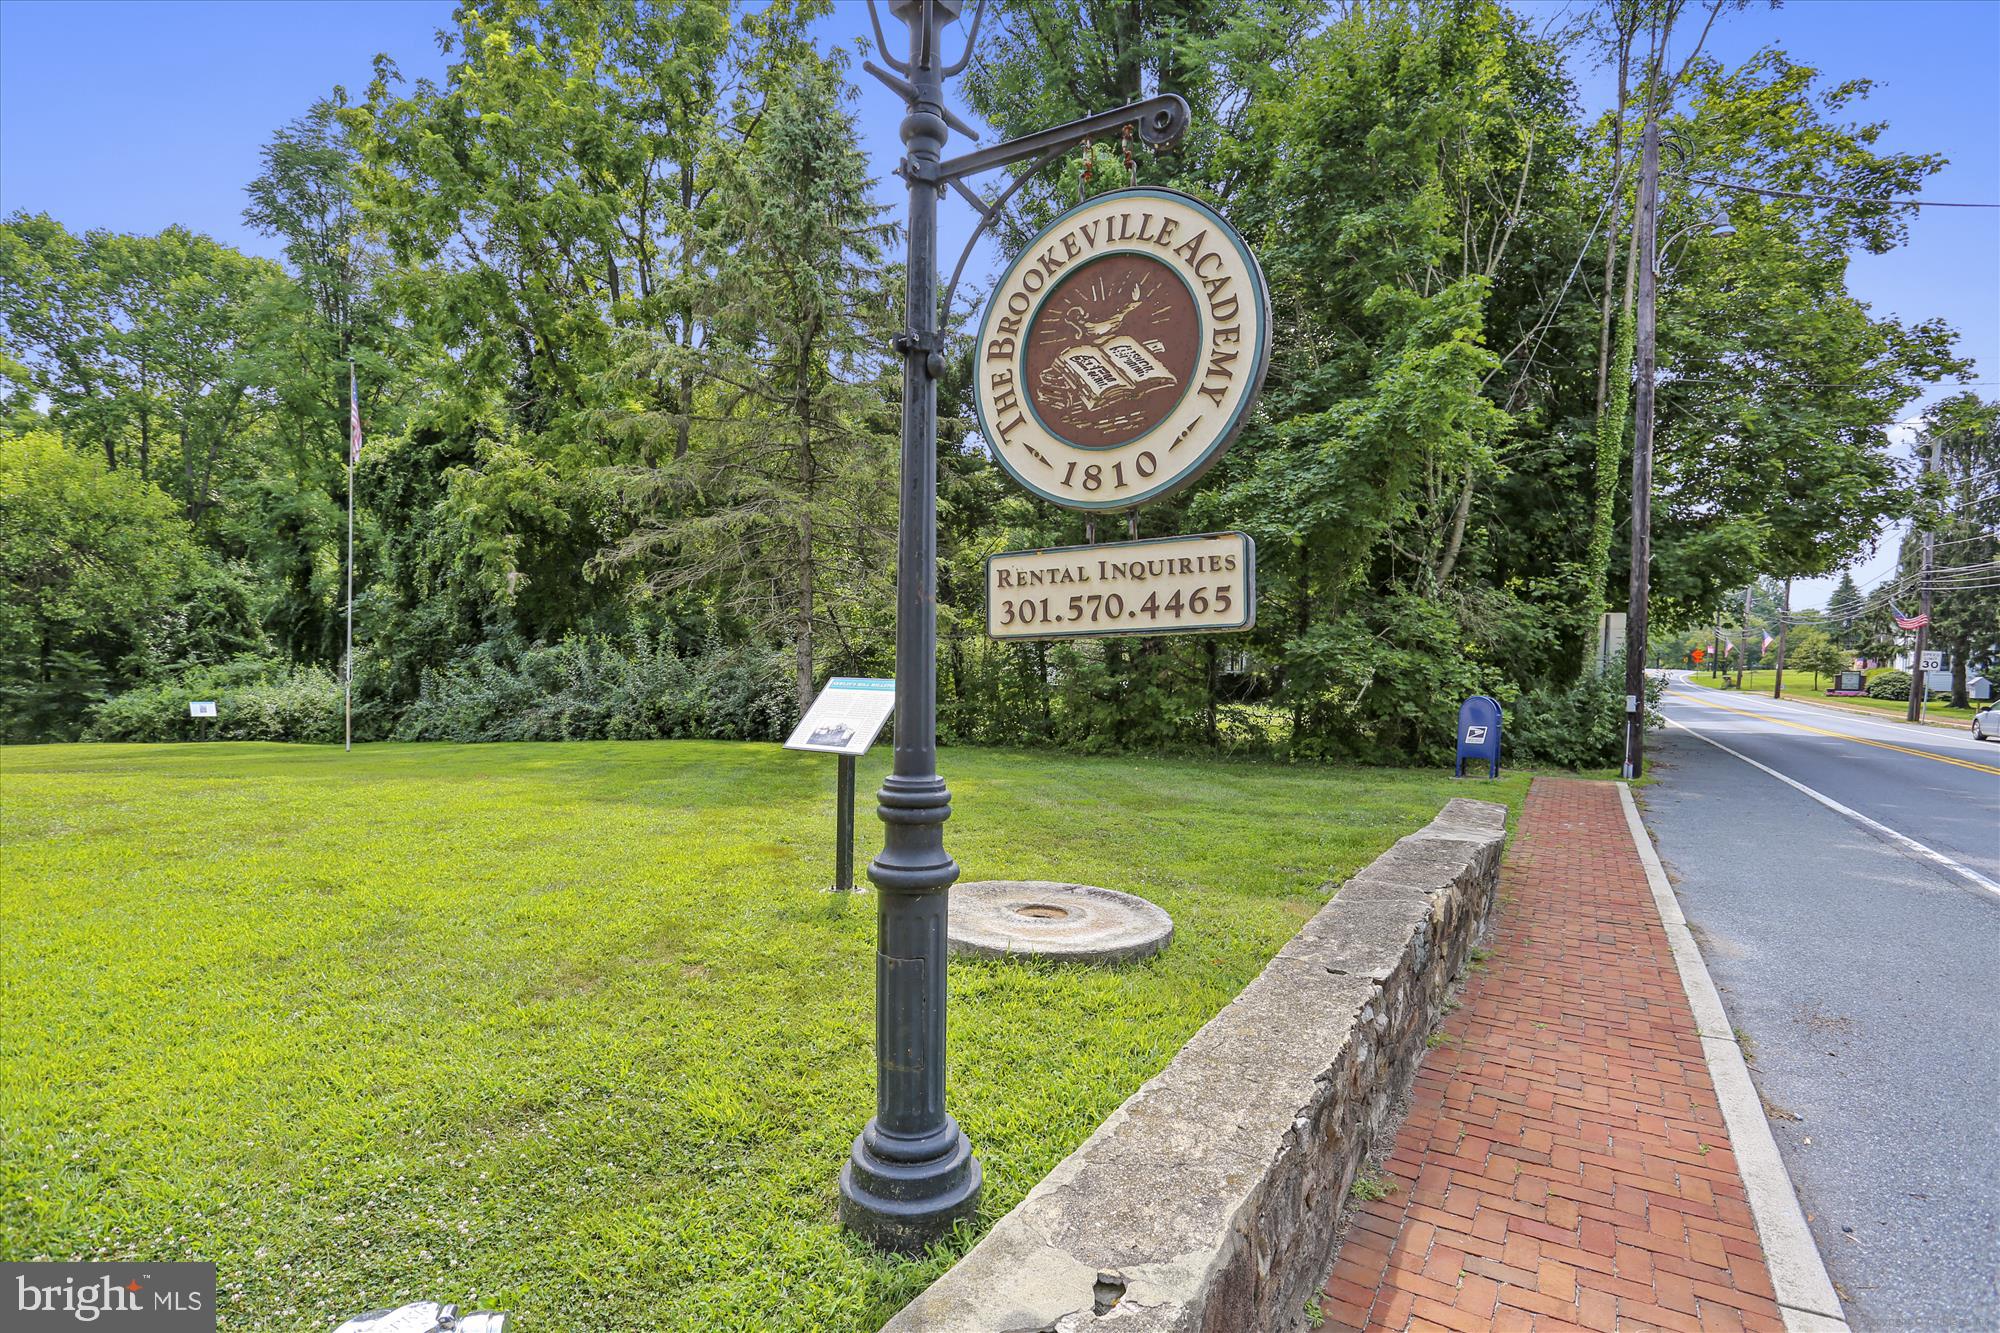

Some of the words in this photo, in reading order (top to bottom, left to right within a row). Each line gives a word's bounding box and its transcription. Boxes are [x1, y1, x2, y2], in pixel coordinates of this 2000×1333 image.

[987, 213, 1179, 363] BROOKEVILLE
[1173, 229, 1241, 408] ACADEMY
[990, 369, 1027, 446] THE
[1060, 450, 1157, 491] 1810
[997, 566, 1090, 588] RENTAL
[1099, 554, 1237, 582] INQUIRIES
[1000, 584, 1232, 626] 301.570.4465
[1922, 660, 1939, 669] 30
